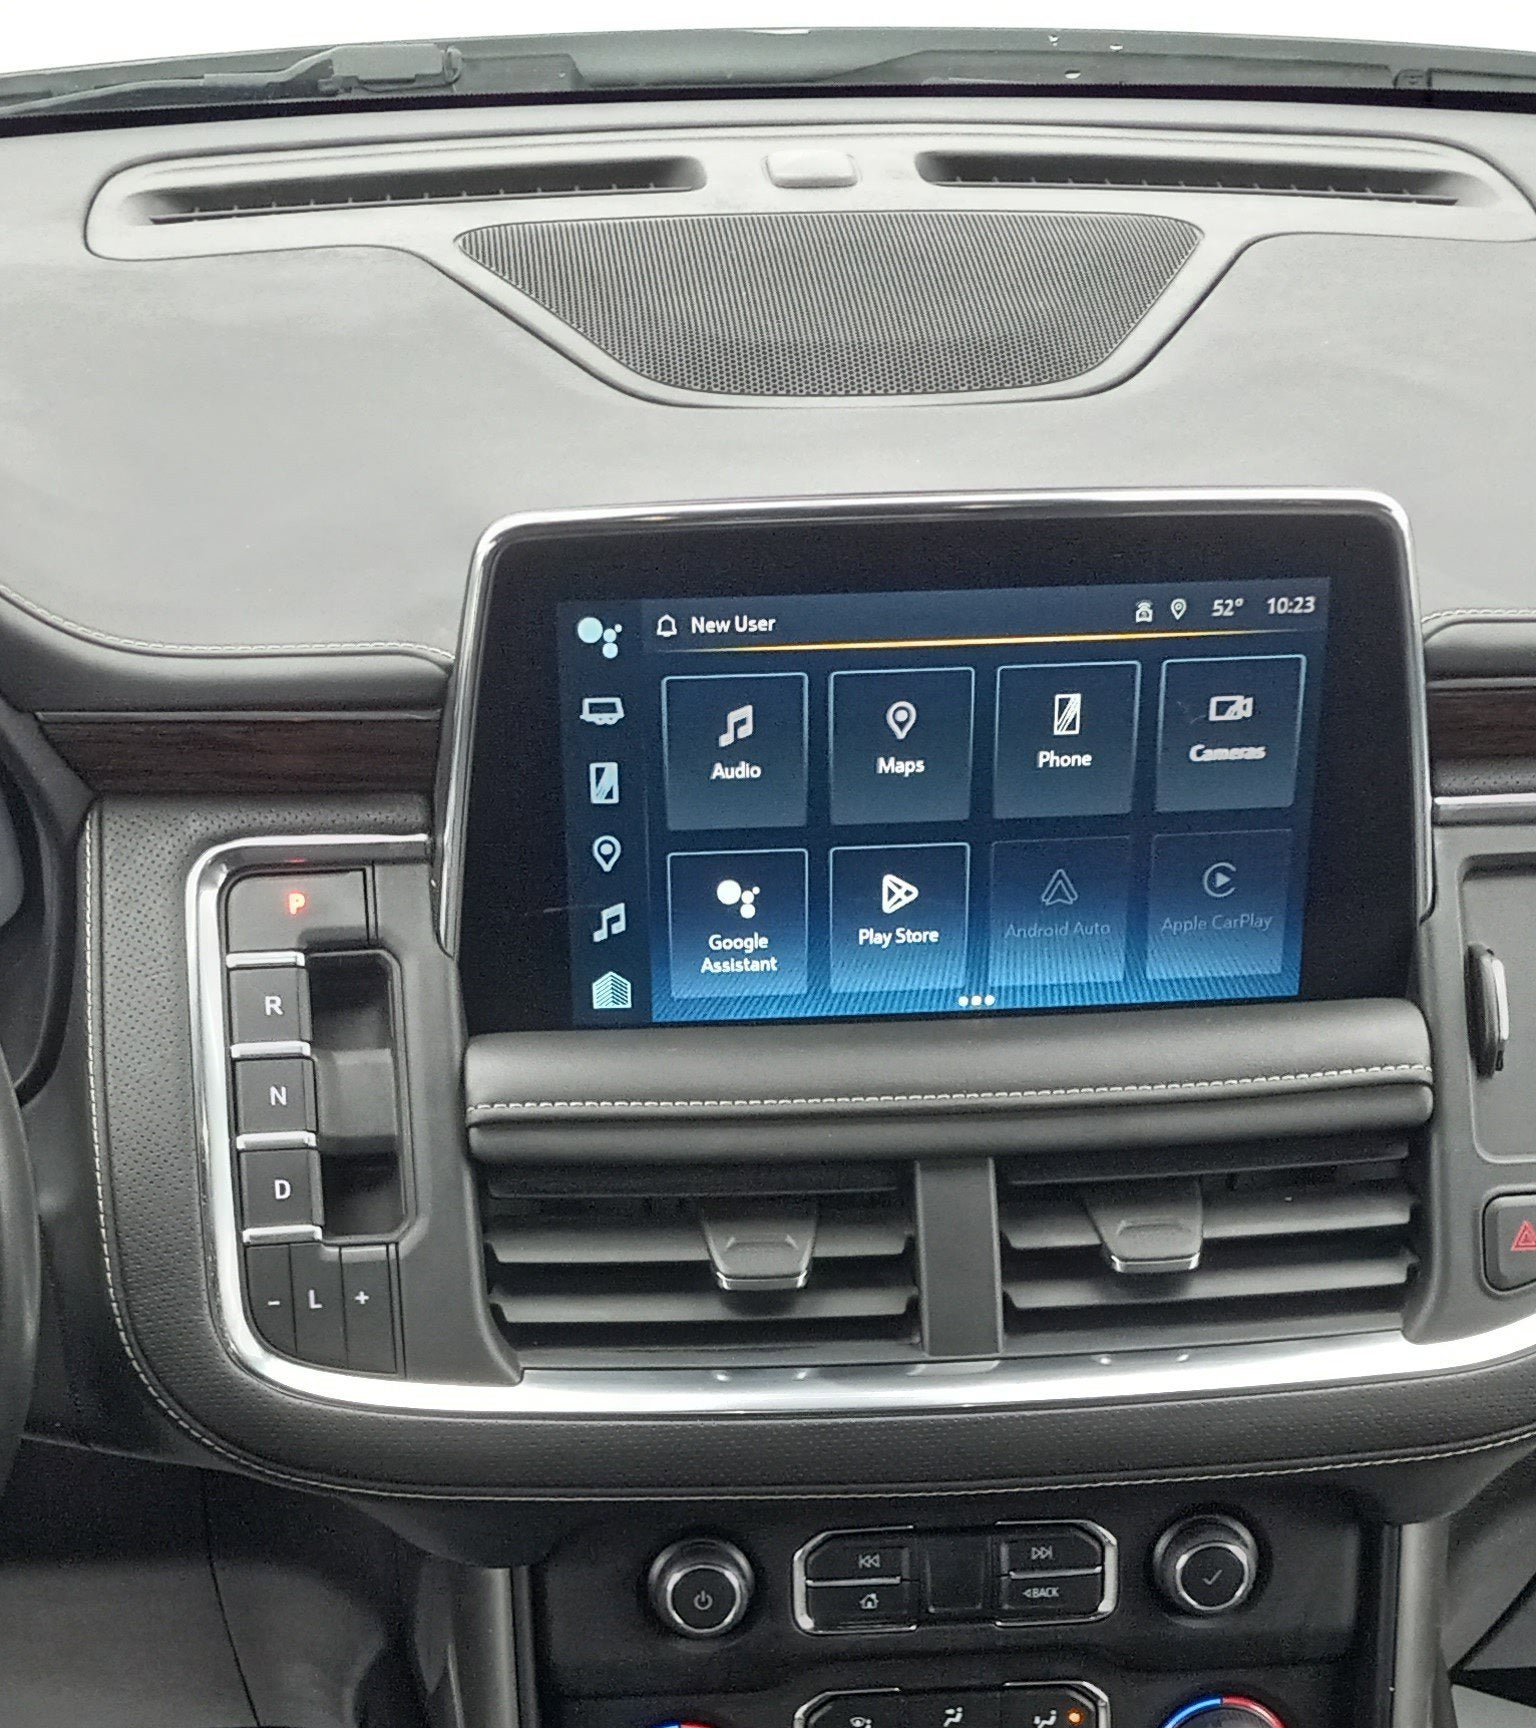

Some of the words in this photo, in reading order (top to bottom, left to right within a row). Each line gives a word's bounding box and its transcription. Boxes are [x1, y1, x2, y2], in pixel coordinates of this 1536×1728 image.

[1267, 596, 1316, 615] 10:23
[691, 616, 730, 634] New
[734, 615, 776, 633] User
[1037, 751, 1093, 768] Phone
[1189, 744, 1267, 764] Cameras
[711, 762, 762, 780] Audio
[877, 757, 925, 777] Maps
[288, 894, 305, 914] P
[1004, 921, 1068, 938] Android
[1073, 920, 1111, 936] Auto
[1161, 915, 1207, 935] Apple
[1212, 913, 1273, 932] CarPlay
[708, 932, 769, 953] Google
[859, 928, 892, 949] Play
[895, 927, 939, 945] Store
[700, 957, 778, 974] Assistant
[265, 996, 284, 1016] R
[270, 1086, 288, 1107] N
[274, 1179, 292, 1200] D
[308, 1290, 323, 1310] L
[1032, 1586, 1060, 1598] BACK
